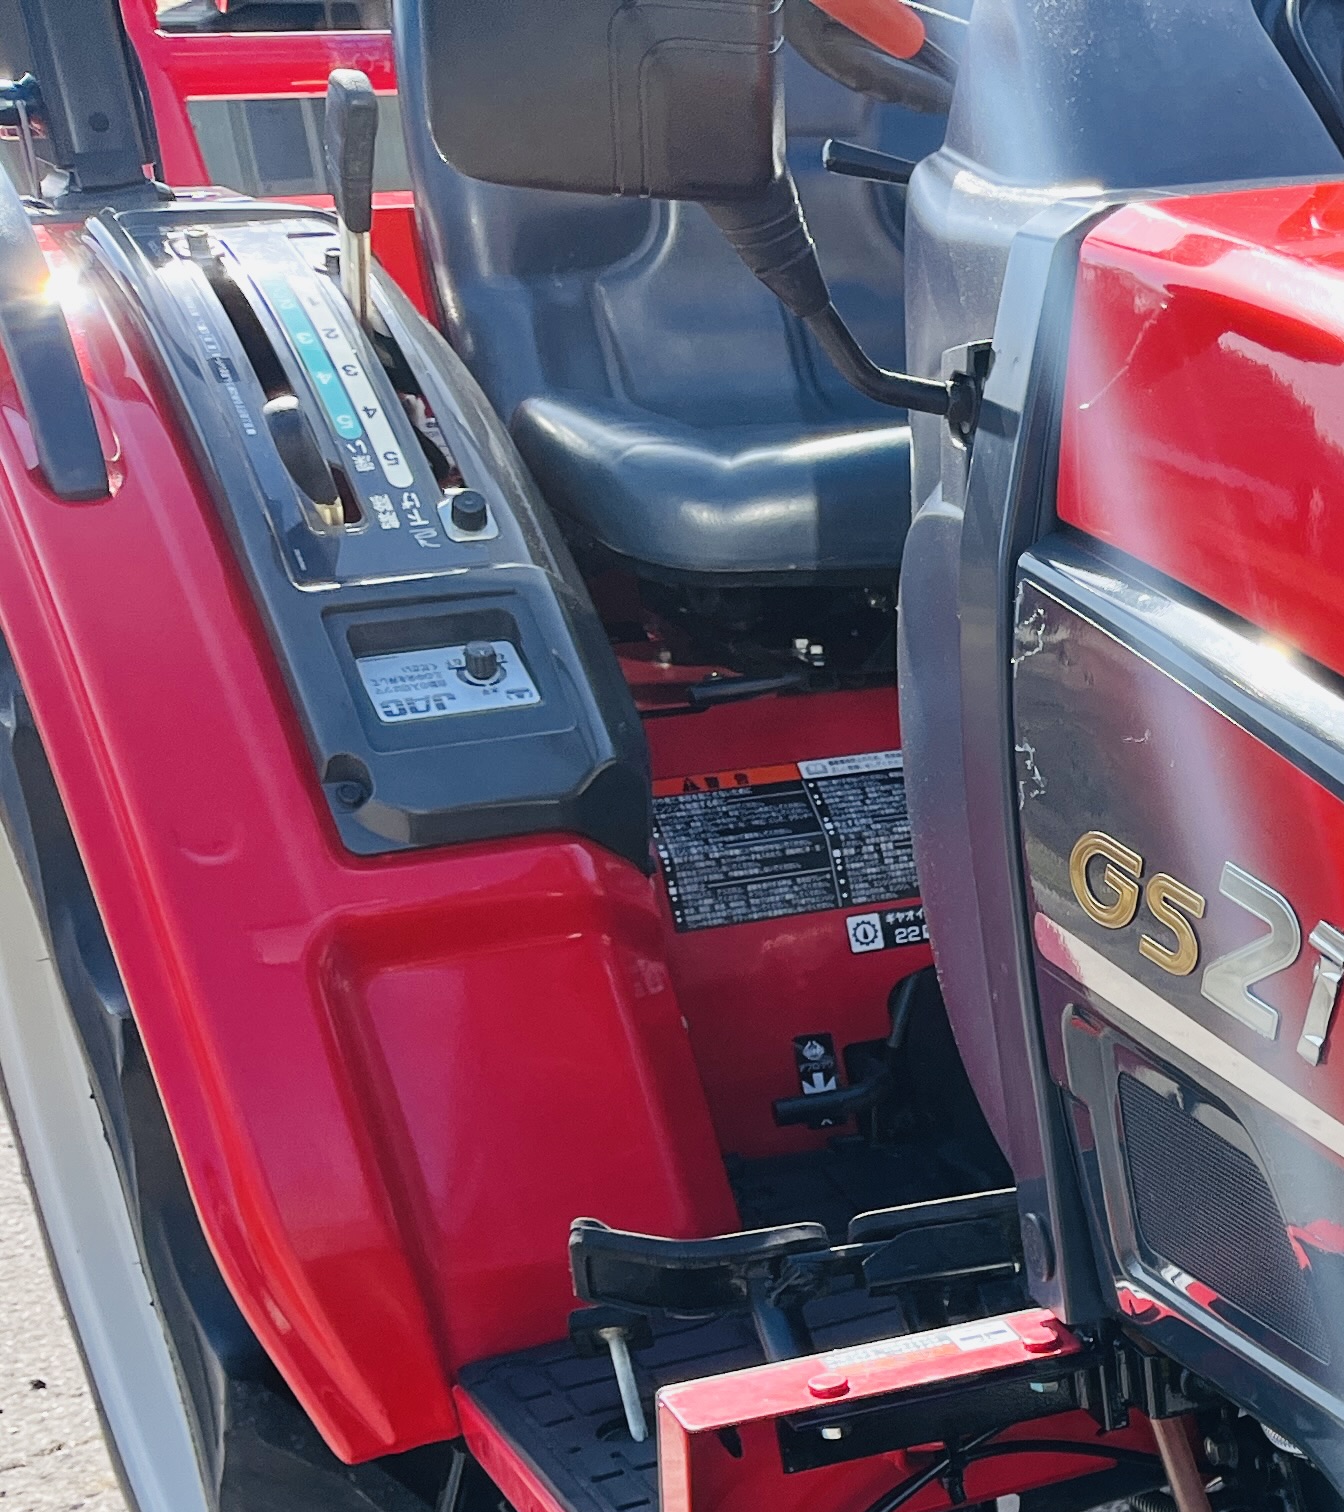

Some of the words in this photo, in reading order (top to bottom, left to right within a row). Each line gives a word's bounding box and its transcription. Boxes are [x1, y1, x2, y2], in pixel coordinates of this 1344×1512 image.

[296, 331, 315, 345] 3
[321, 326, 340, 340] 2
[342, 363, 360, 377] 3
[316, 372, 332, 385] 4
[362, 405, 378, 420] 4
[336, 414, 354, 430] 5
[382, 450, 401, 467] 5
[380, 692, 457, 717] JAC
